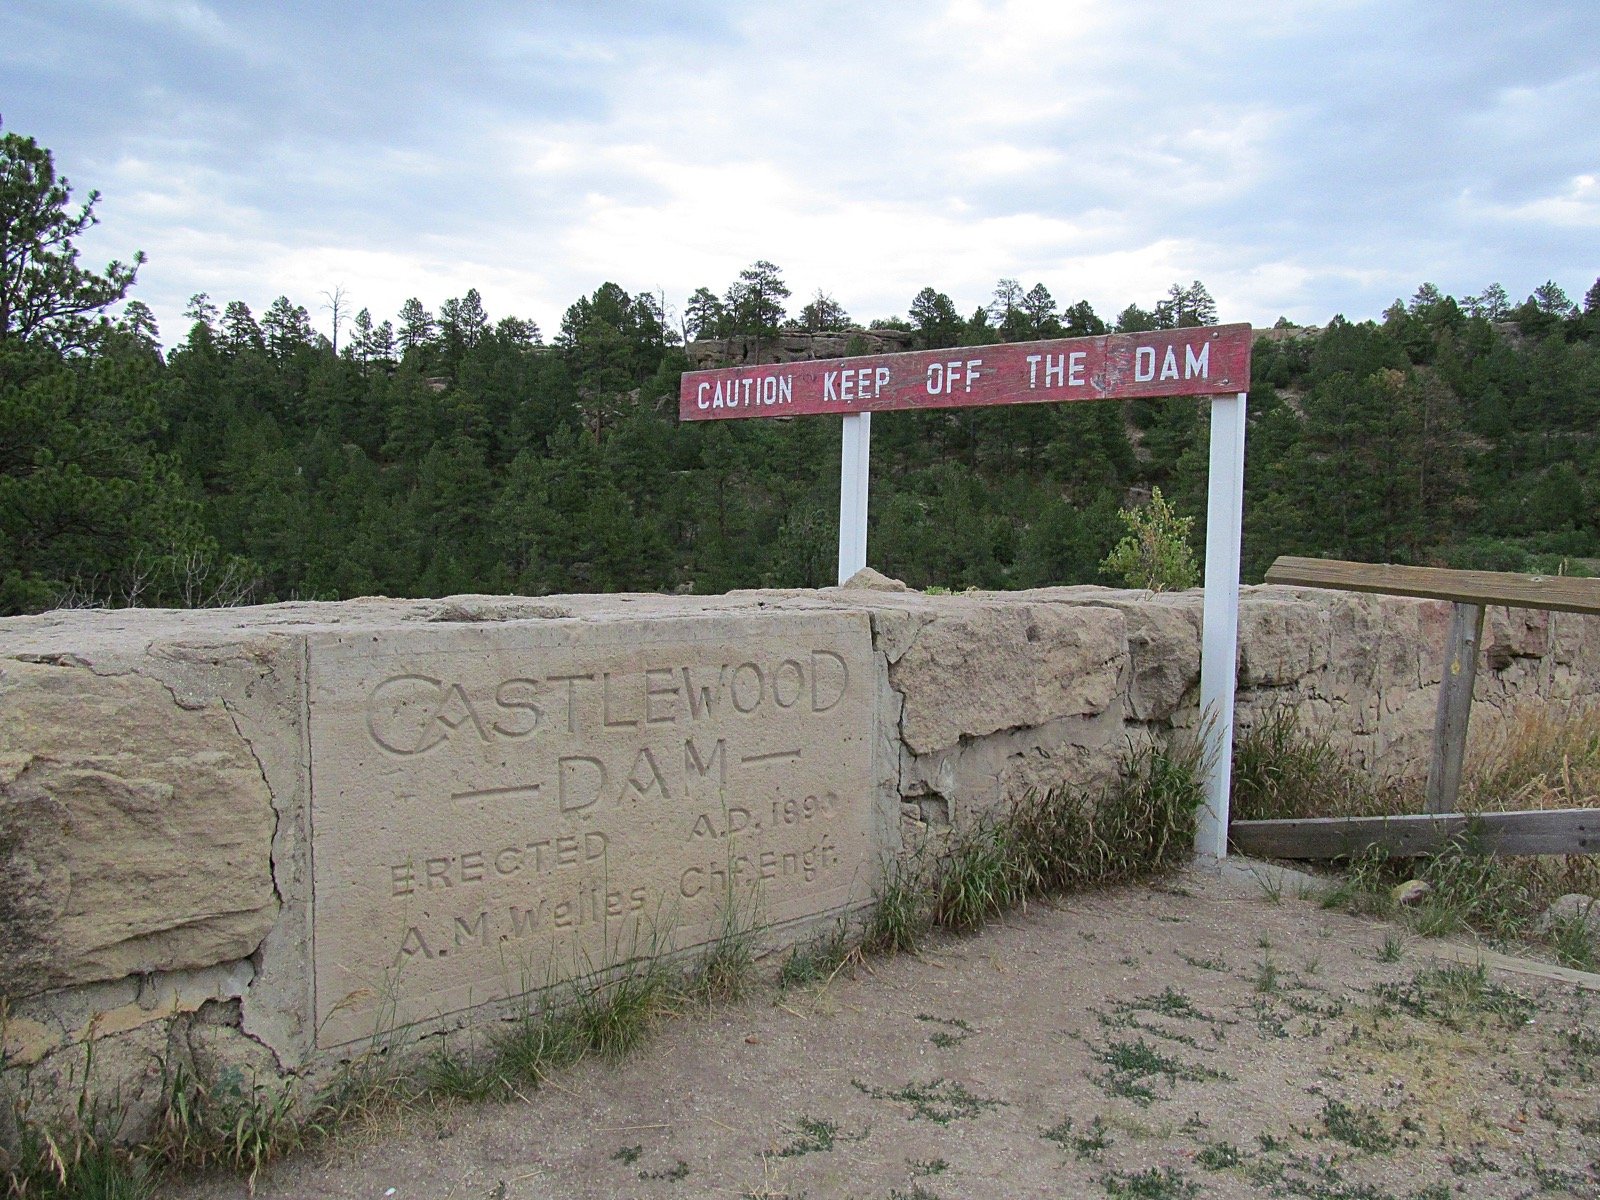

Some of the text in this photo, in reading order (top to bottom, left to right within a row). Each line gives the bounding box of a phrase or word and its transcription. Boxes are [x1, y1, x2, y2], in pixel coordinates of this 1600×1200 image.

[697, 341, 1210, 409] CAUTION KEEP OFF THE DAM
[366, 648, 849, 756] CASTLEWOOD
[558, 738, 727, 814] DAM
[391, 831, 610, 897] ERECTED
